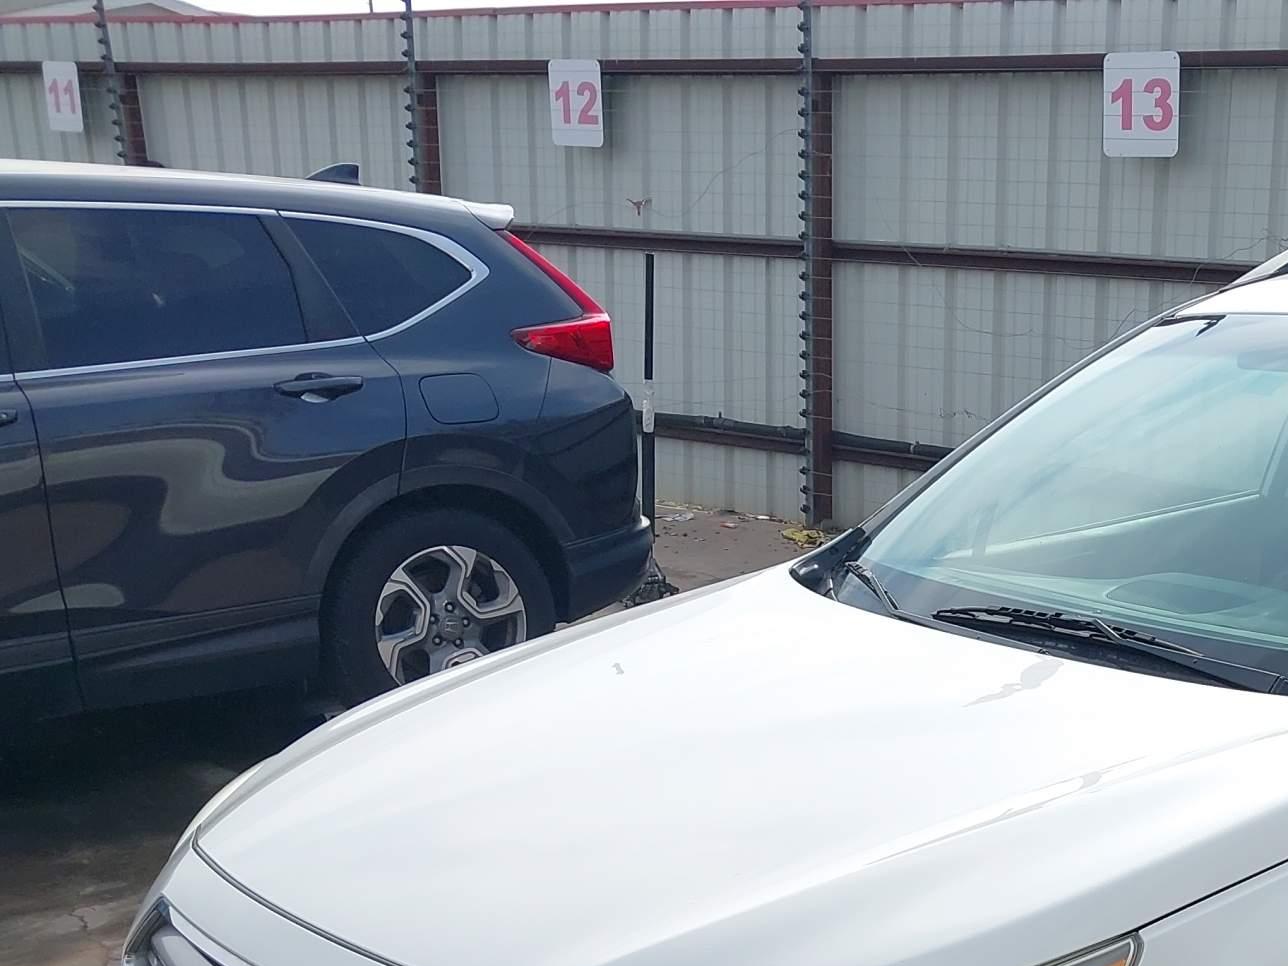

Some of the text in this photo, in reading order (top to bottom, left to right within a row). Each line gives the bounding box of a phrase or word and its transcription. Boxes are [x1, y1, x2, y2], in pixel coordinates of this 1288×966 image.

[48, 79, 77, 115] 11
[554, 82, 597, 126] 12
[1111, 78, 1174, 133] 13
